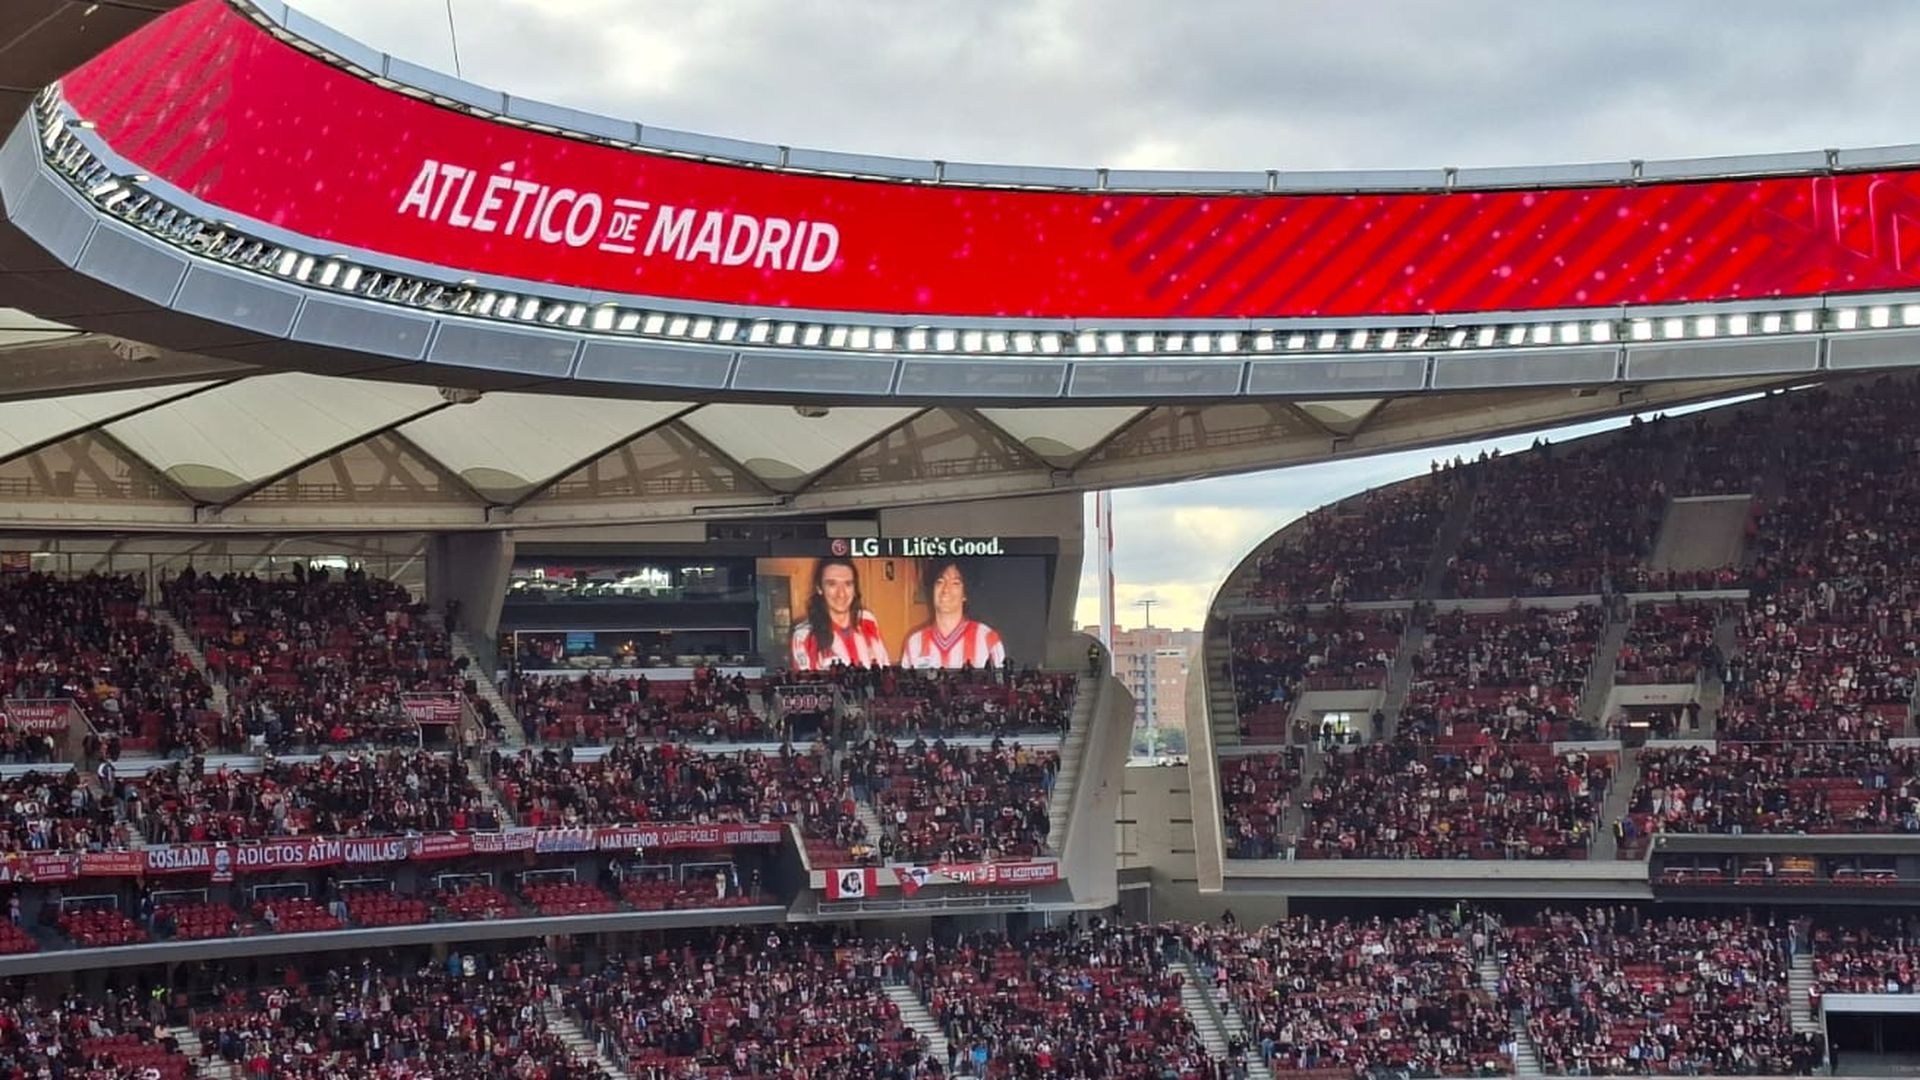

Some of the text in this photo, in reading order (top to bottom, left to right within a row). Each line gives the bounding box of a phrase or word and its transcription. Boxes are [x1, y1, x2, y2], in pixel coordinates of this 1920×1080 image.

[398, 159, 840, 272] ATLÉTICO DE MADRID
[850, 537, 1004, 557] LG Life's Good.
[600, 835, 622, 849] MAR
[623, 831, 659, 848] MENOR
[148, 847, 209, 869] COSLADA
[237, 841, 340, 865] ADICTOS ATM
[344, 841, 397, 862] CANILLAS
